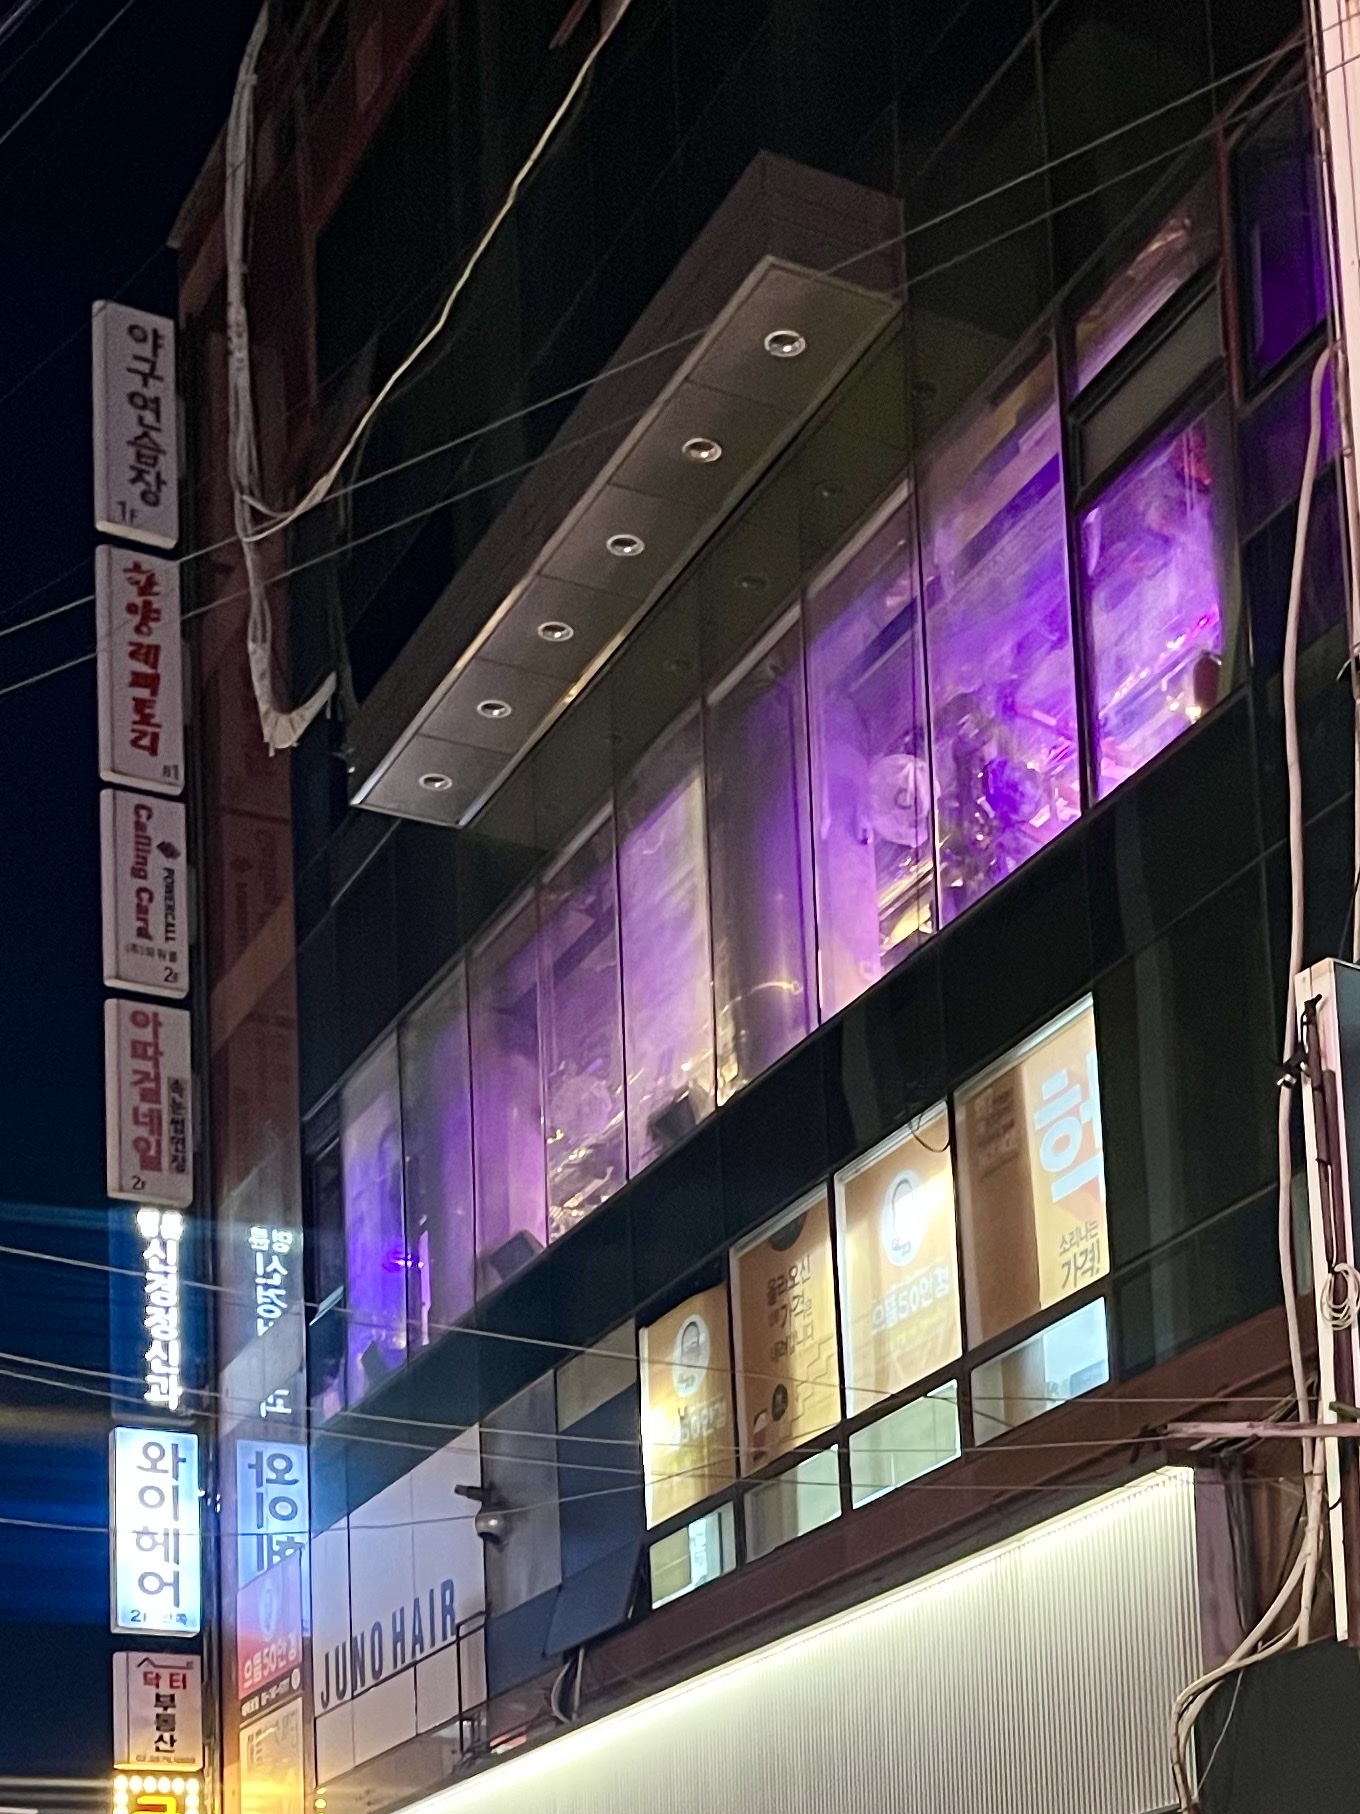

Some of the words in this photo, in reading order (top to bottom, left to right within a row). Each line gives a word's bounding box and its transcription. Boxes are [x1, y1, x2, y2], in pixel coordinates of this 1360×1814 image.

[126, 323, 168, 508] 야구연습장
[130, 803, 154, 881] Calling
[135, 886, 155, 942] Card
[136, 1441, 187, 1608] 와이헤어
[320, 1621, 383, 1710] JUNO
[391, 1578, 458, 1671] HAIR
